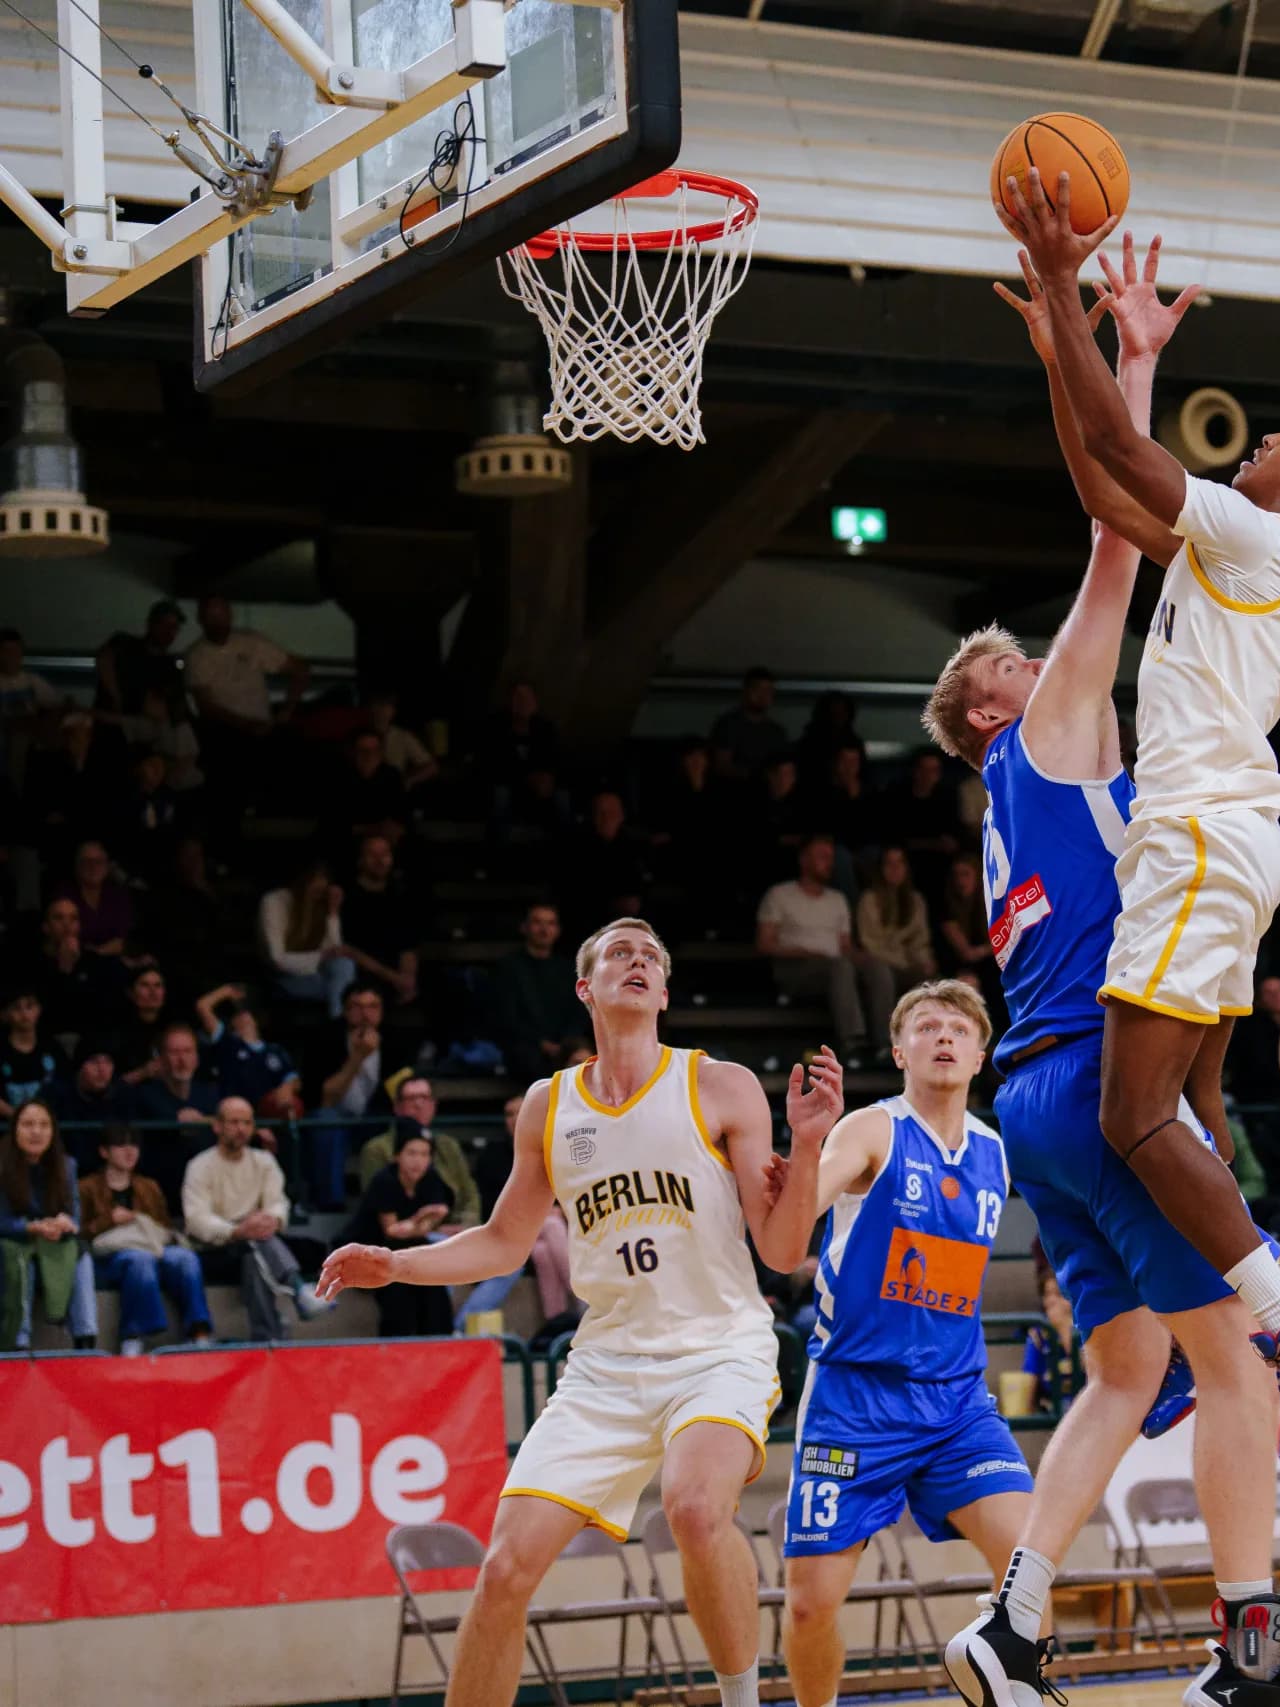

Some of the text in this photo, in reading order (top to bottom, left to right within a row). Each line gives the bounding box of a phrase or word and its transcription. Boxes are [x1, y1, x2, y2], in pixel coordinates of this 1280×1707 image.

[575, 1170, 695, 1236] BERLIN
[976, 1189, 1002, 1239] 13
[616, 1237, 658, 1277] 16
[886, 1281, 952, 1310] STADE
[800, 1480, 841, 1528] 13
[791, 1533, 829, 1543] SPALDING
